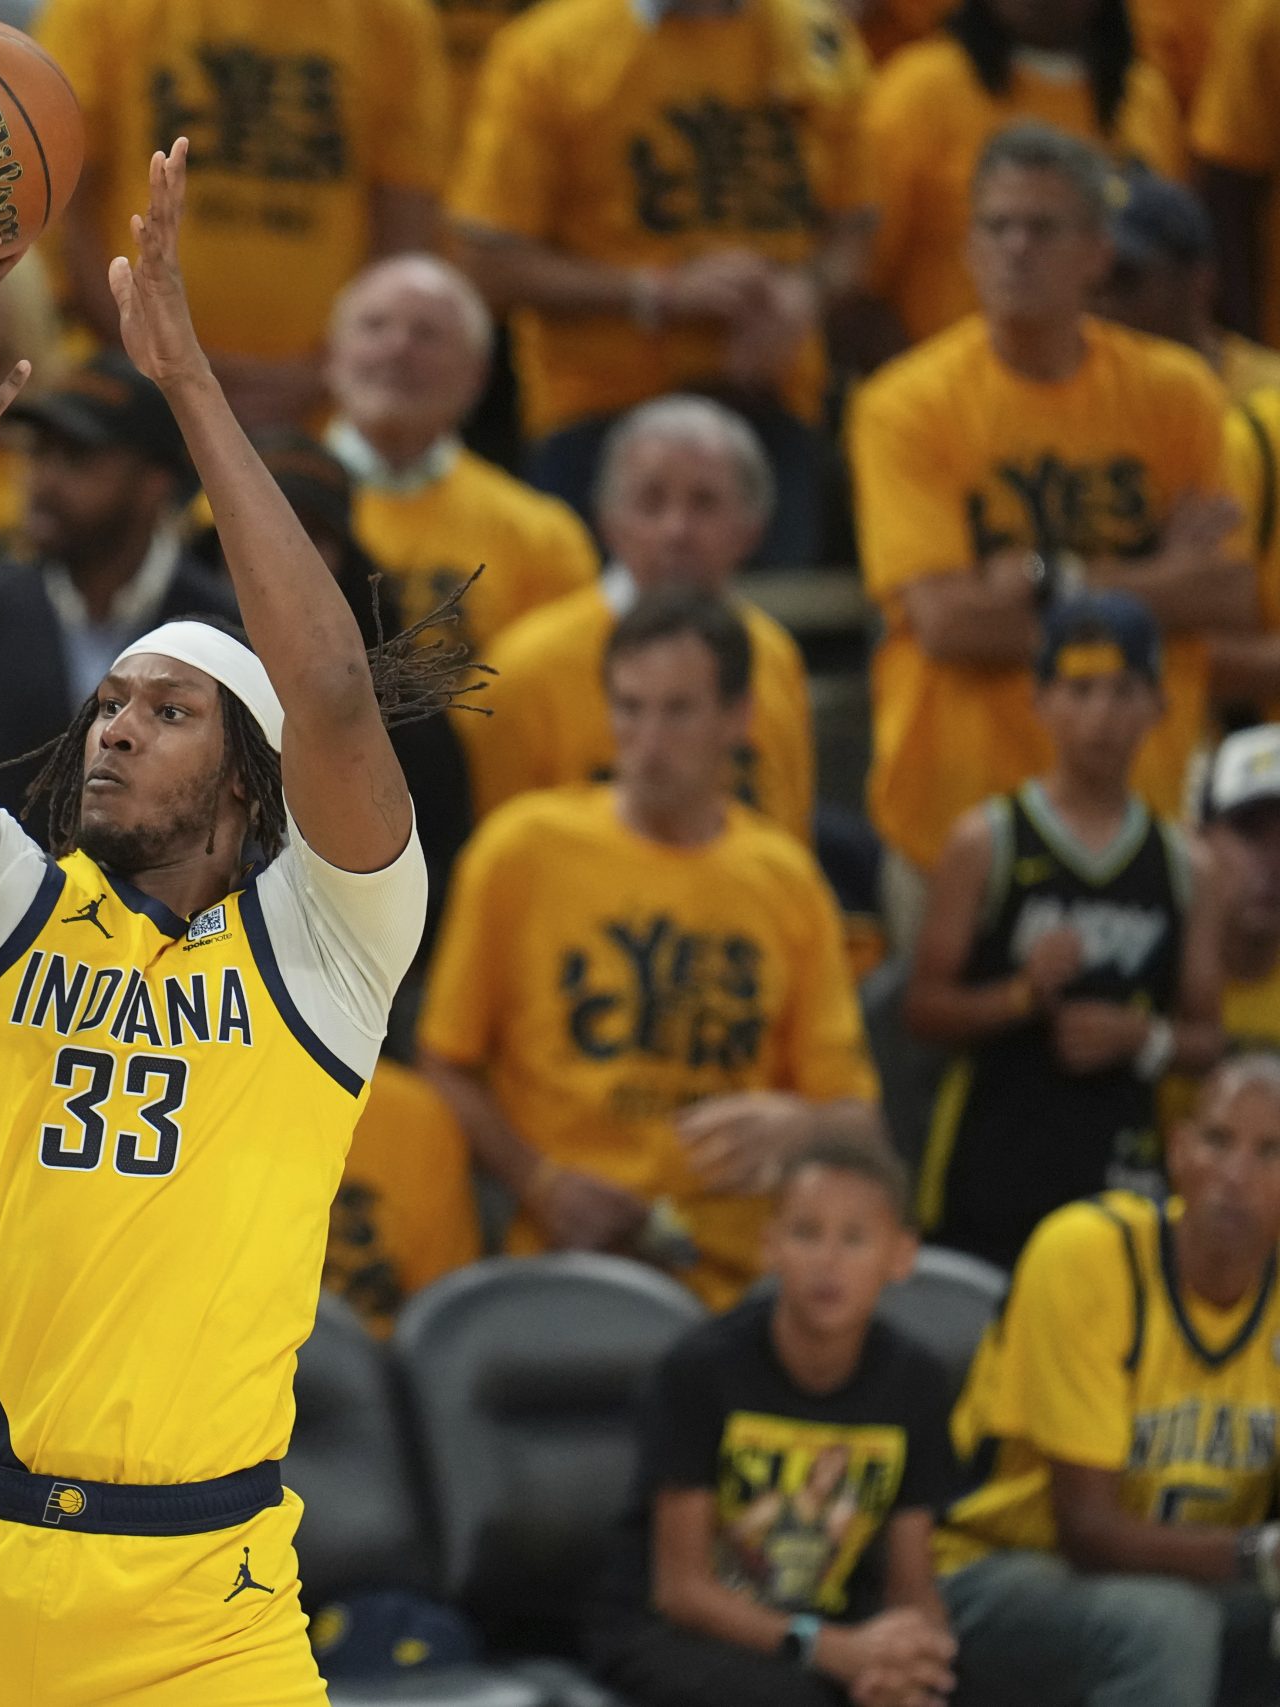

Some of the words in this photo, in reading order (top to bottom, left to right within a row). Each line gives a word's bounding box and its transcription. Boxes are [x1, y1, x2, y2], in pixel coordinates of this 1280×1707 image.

[182, 933, 233, 952] spokenote
[9, 949, 254, 1048] INDIANA
[38, 1044, 190, 1178] 33
